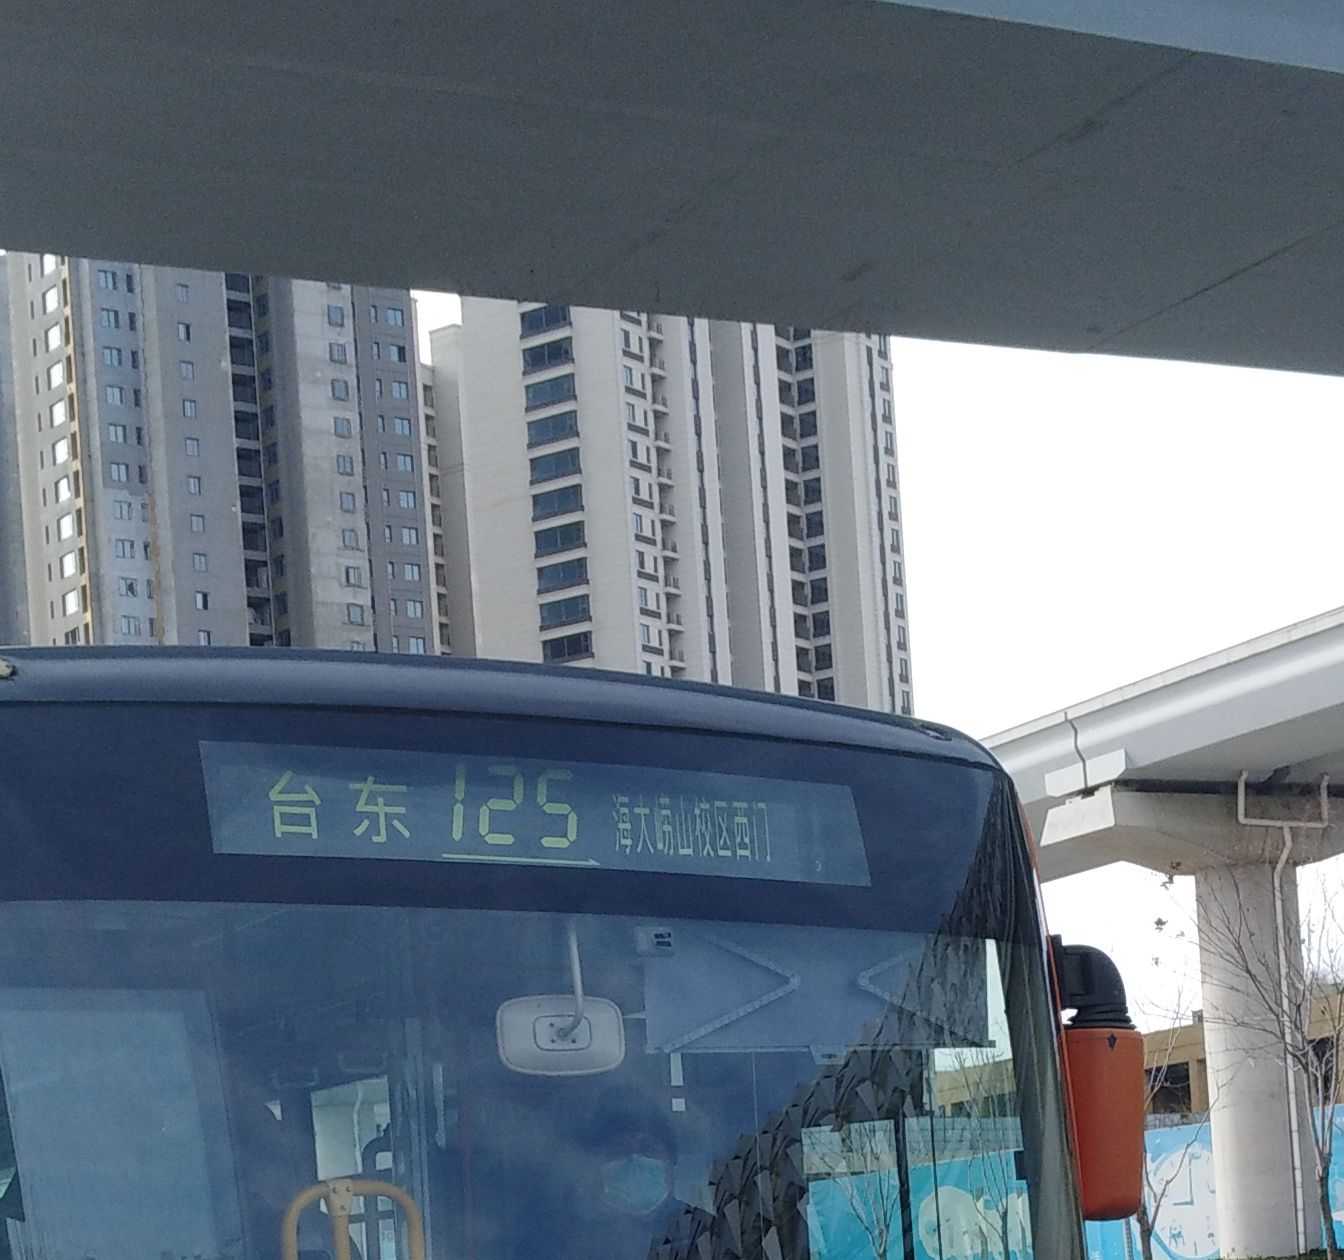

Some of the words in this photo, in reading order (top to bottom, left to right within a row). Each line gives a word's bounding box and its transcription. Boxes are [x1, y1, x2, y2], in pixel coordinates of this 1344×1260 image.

[267, 770, 413, 844] 台东
[451, 763, 579, 849] 125
[611, 793, 774, 863] 海大崂山校区西门
